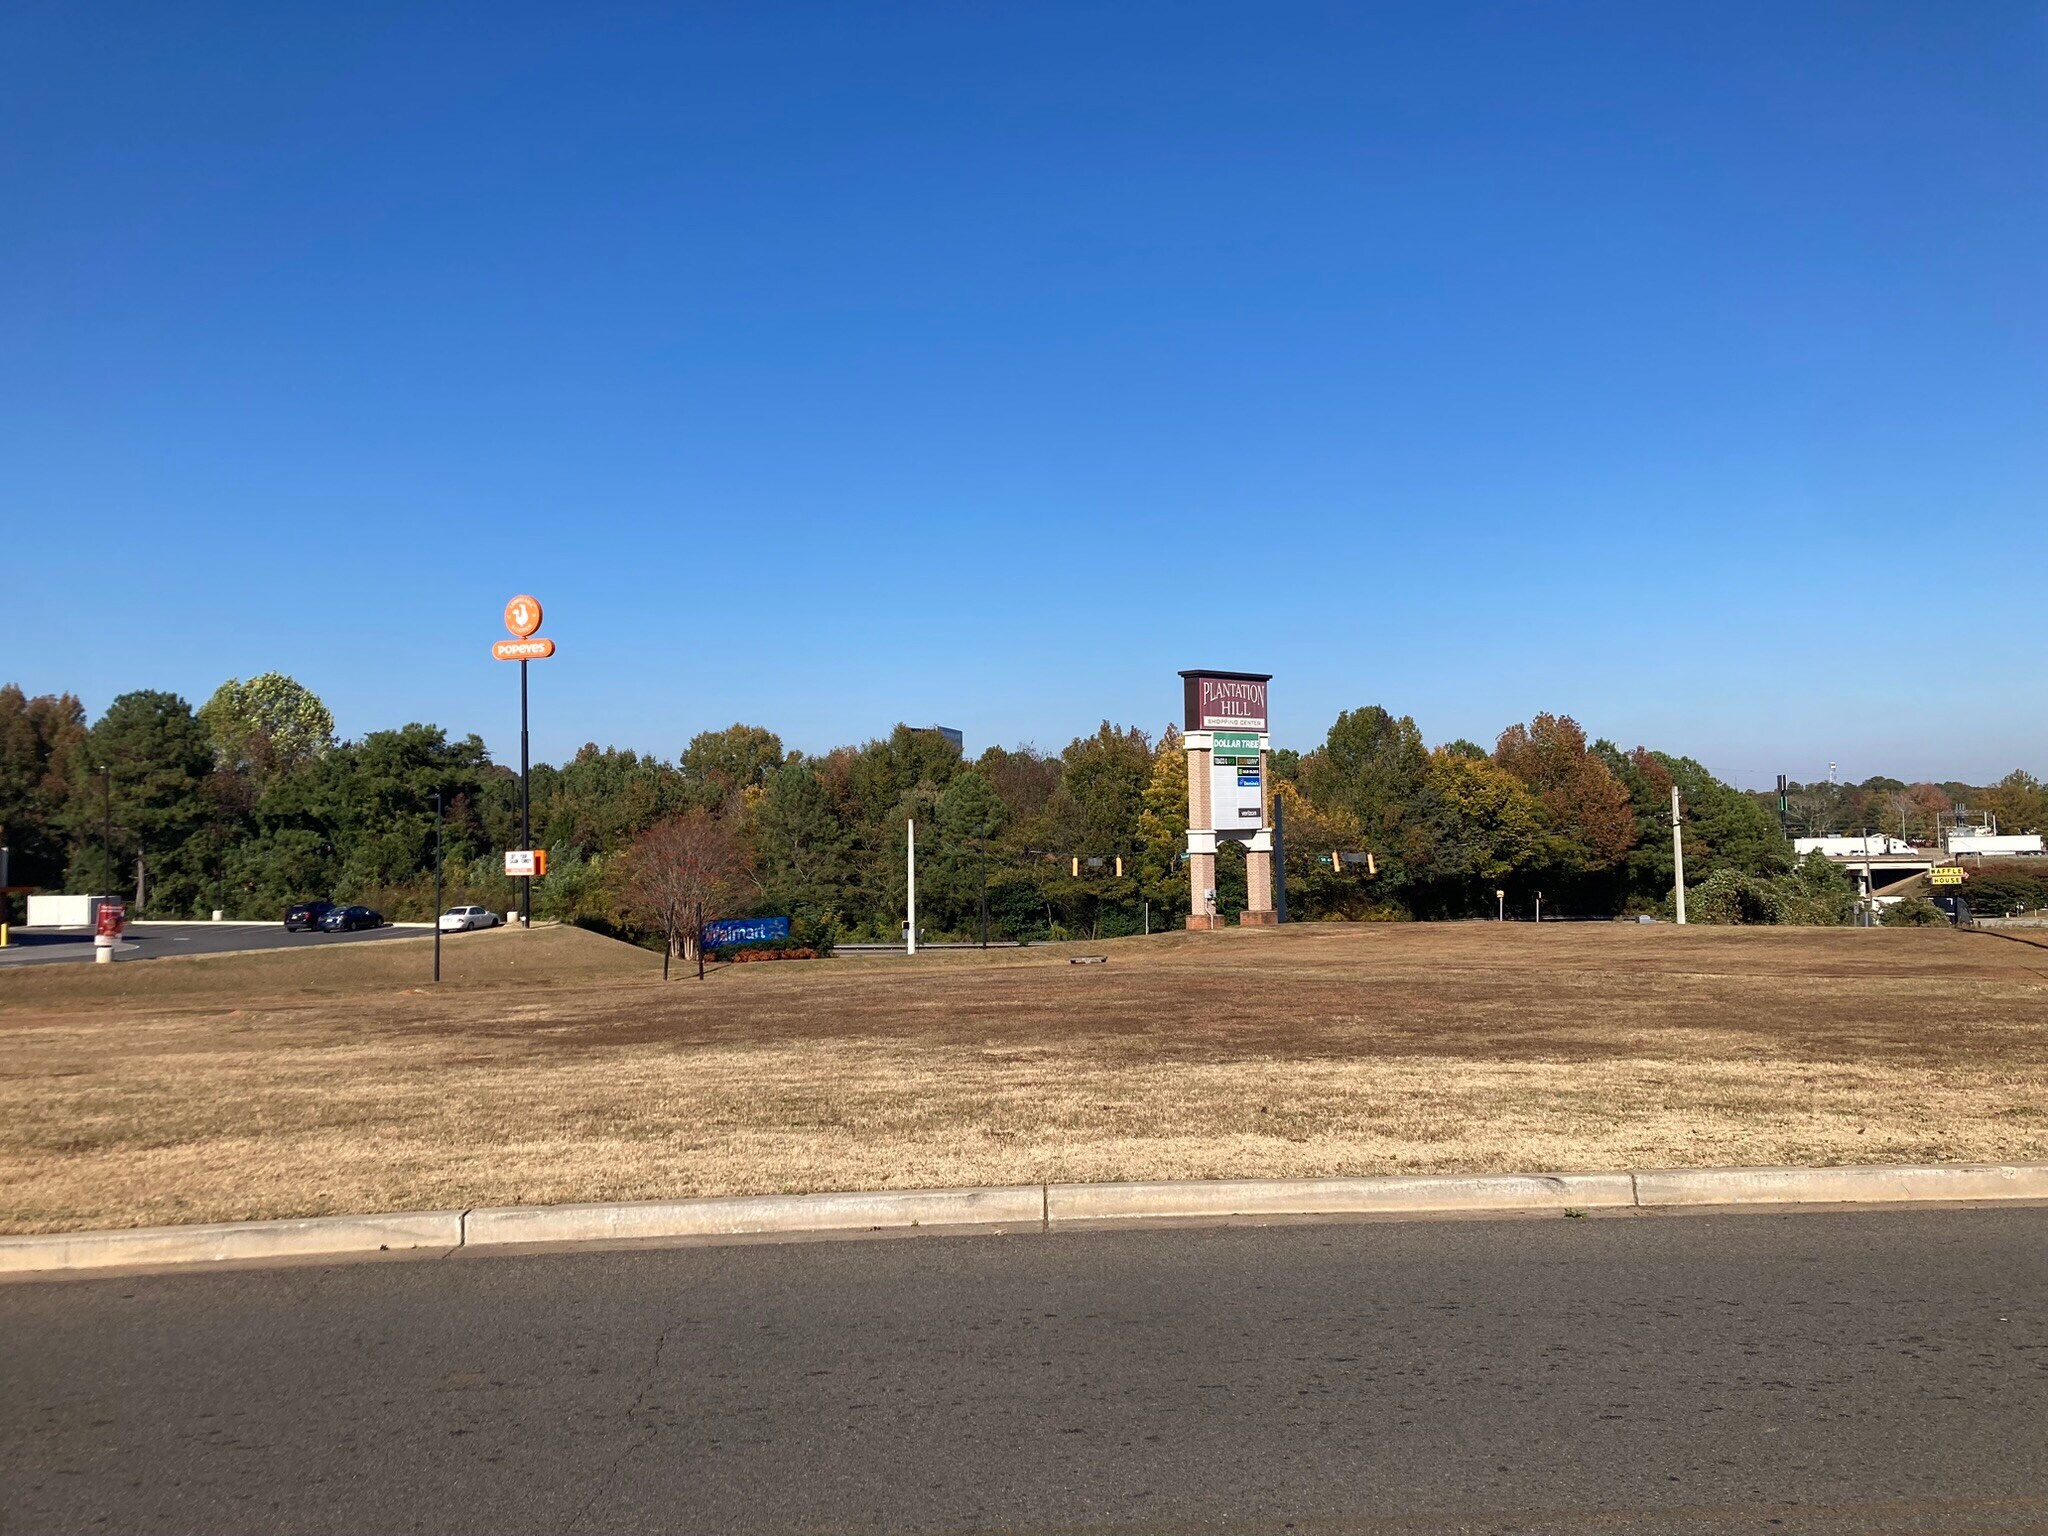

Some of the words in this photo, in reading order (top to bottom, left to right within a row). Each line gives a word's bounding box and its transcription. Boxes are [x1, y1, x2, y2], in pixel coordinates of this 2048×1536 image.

[1203, 682, 1265, 708] PLANTATION
[1221, 701, 1251, 716] HILL
[1213, 739, 1241, 748] DOLLAR
[1241, 739, 1259, 749] TREE
